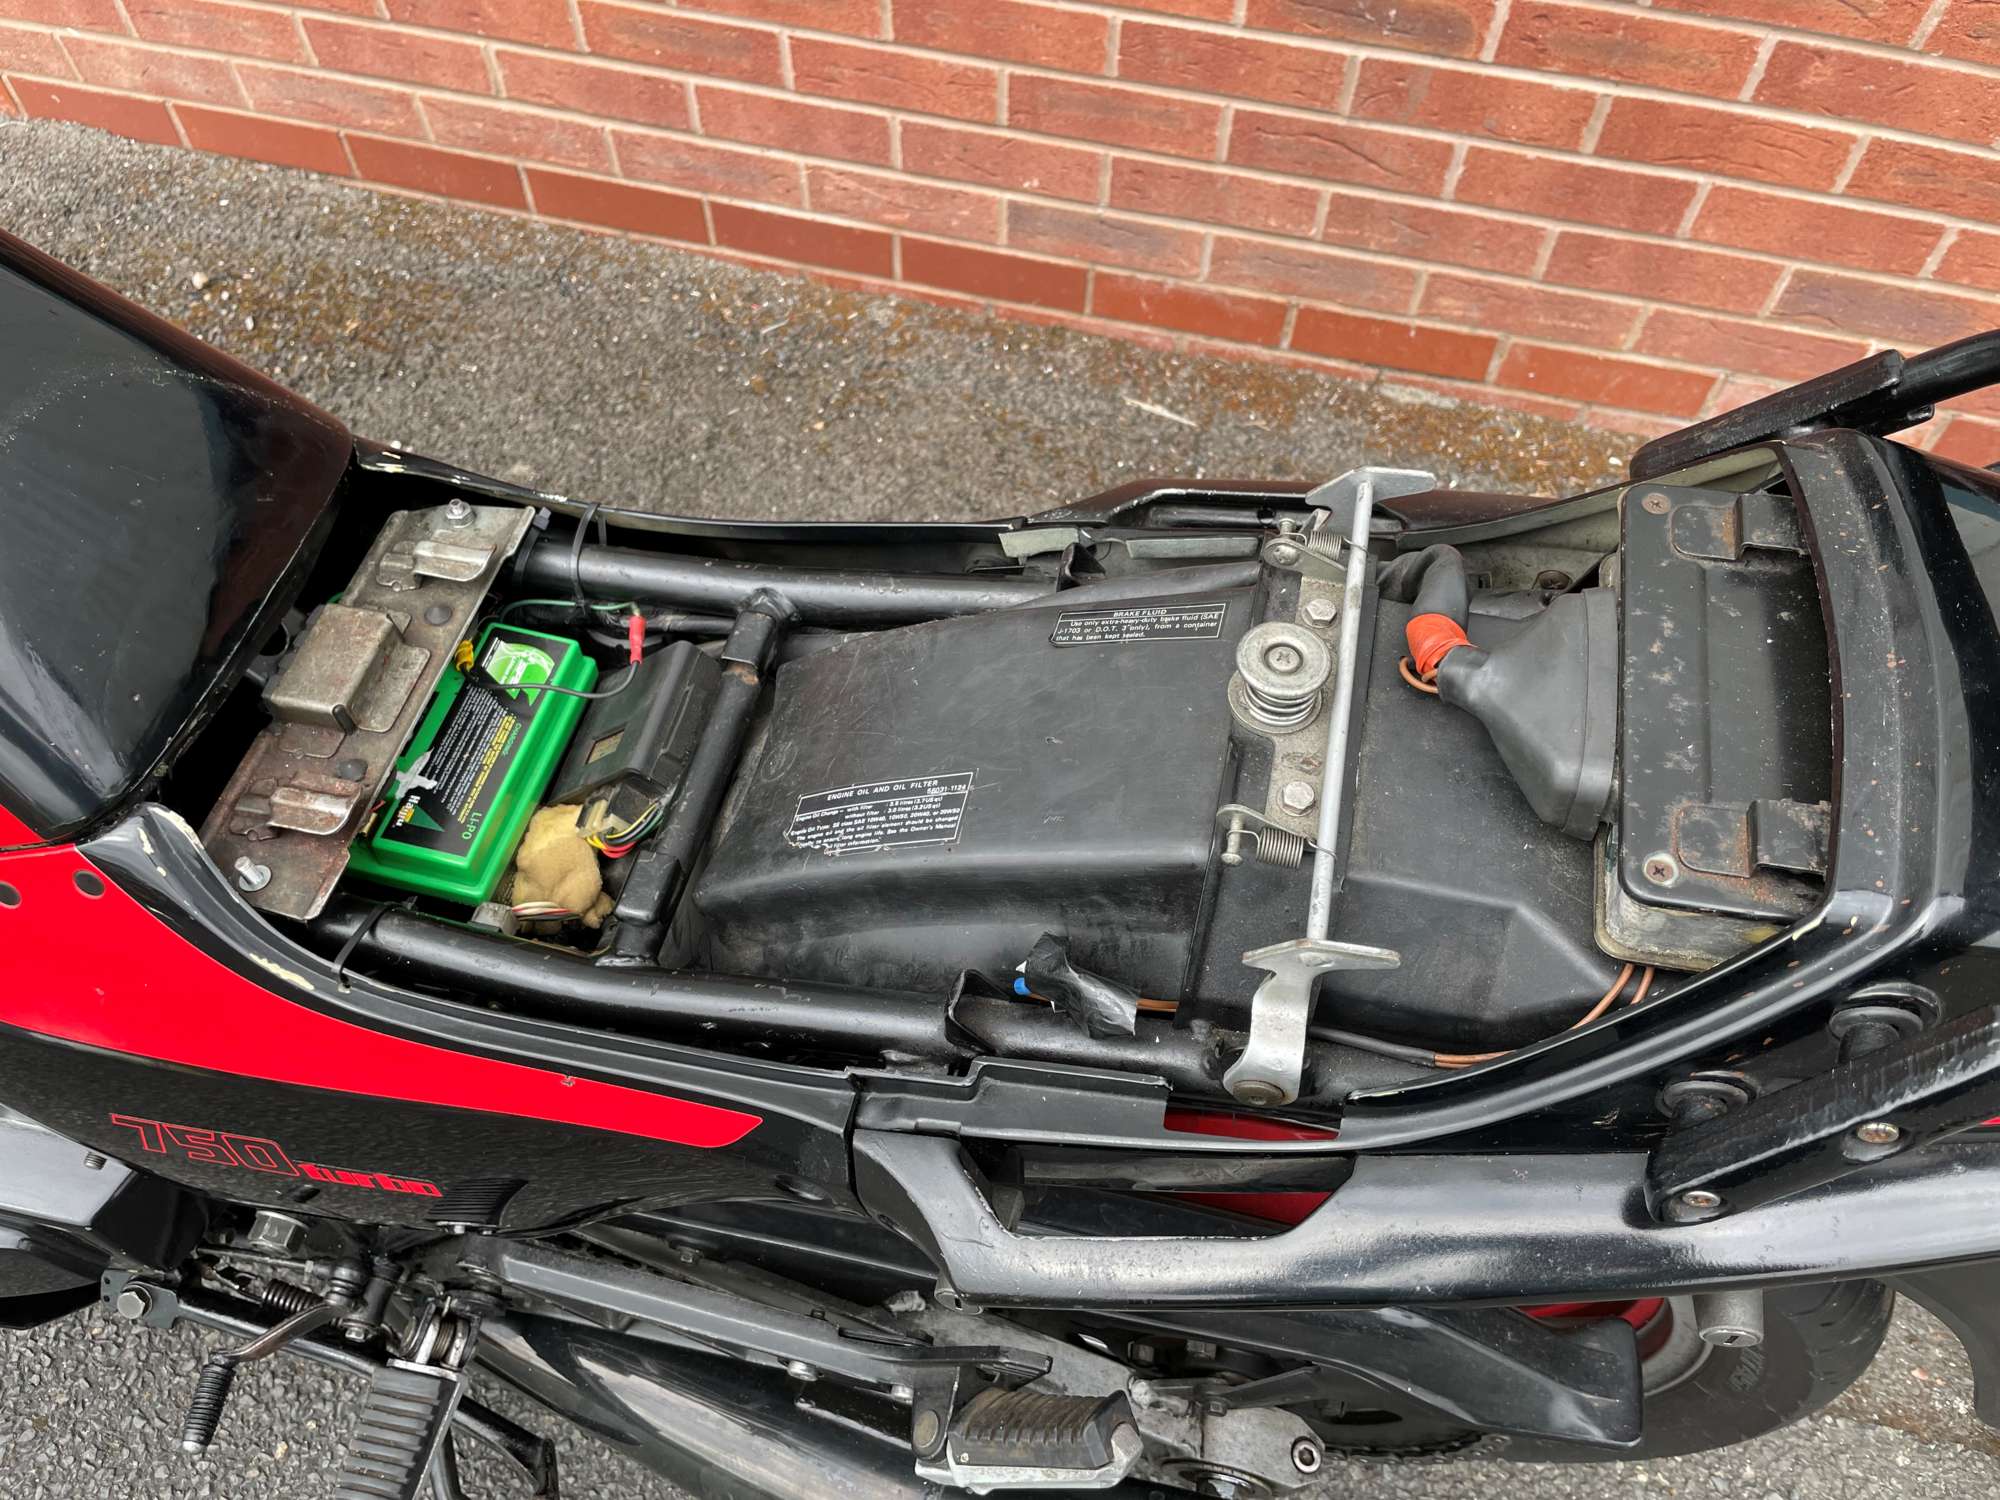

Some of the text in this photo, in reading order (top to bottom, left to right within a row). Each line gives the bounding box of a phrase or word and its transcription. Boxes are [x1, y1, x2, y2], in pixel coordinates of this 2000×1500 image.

[1101, 616, 1157, 625] extra-heavy-duty
[1200, 613, 1218, 621] (SAE
[1096, 625, 1118, 633] D.O.T.
[1183, 621, 1217, 629] container
[827, 780, 938, 801] ENGINE OIL AND OIL FILTER
[881, 820, 904, 828] element
[905, 818, 923, 826] should
[935, 815, 958, 823] changed
[910, 824, 934, 832] Owner's
[108, 1112, 443, 1198] 750 turbo
